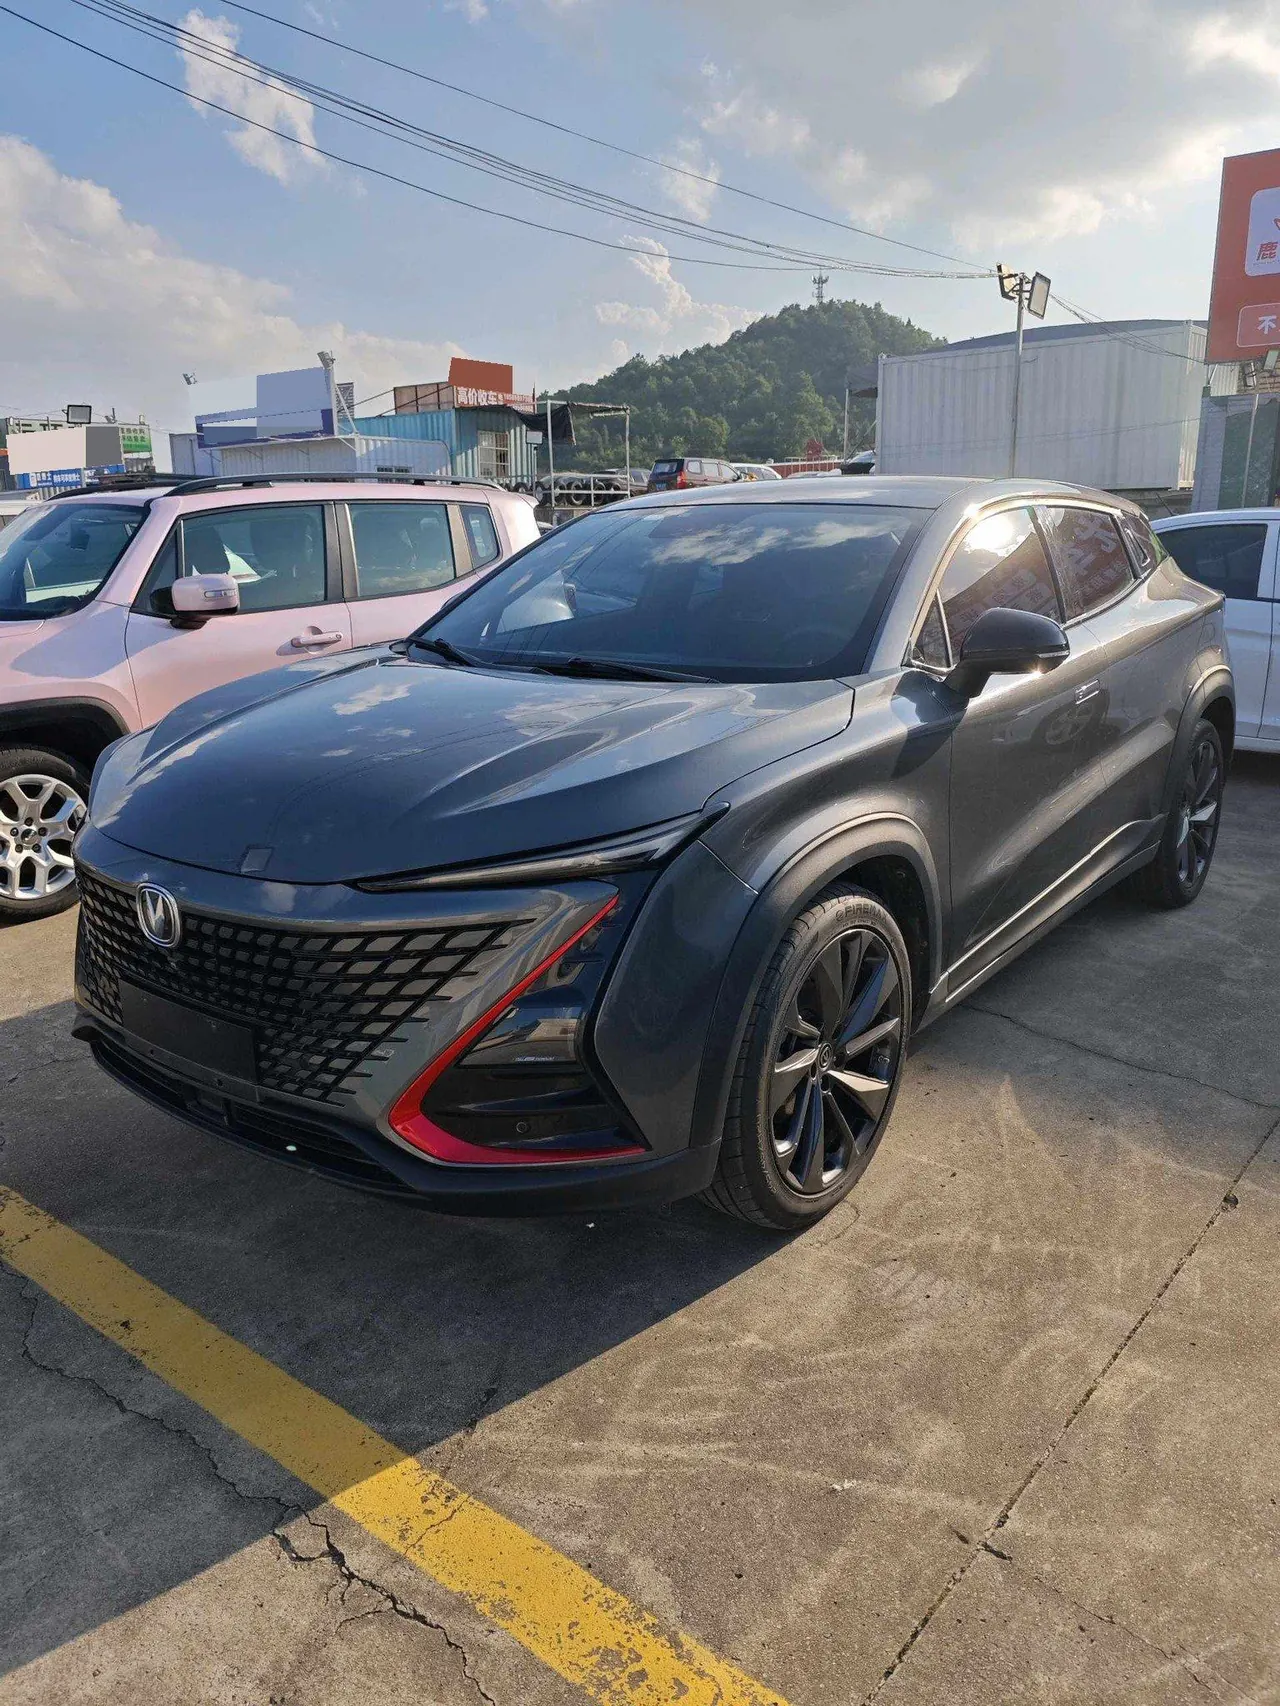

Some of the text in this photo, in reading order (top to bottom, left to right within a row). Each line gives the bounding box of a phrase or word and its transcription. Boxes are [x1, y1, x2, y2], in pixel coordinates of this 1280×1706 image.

[1256, 241, 1279, 261] 鹿
[457, 386, 498, 406] 高价收车
